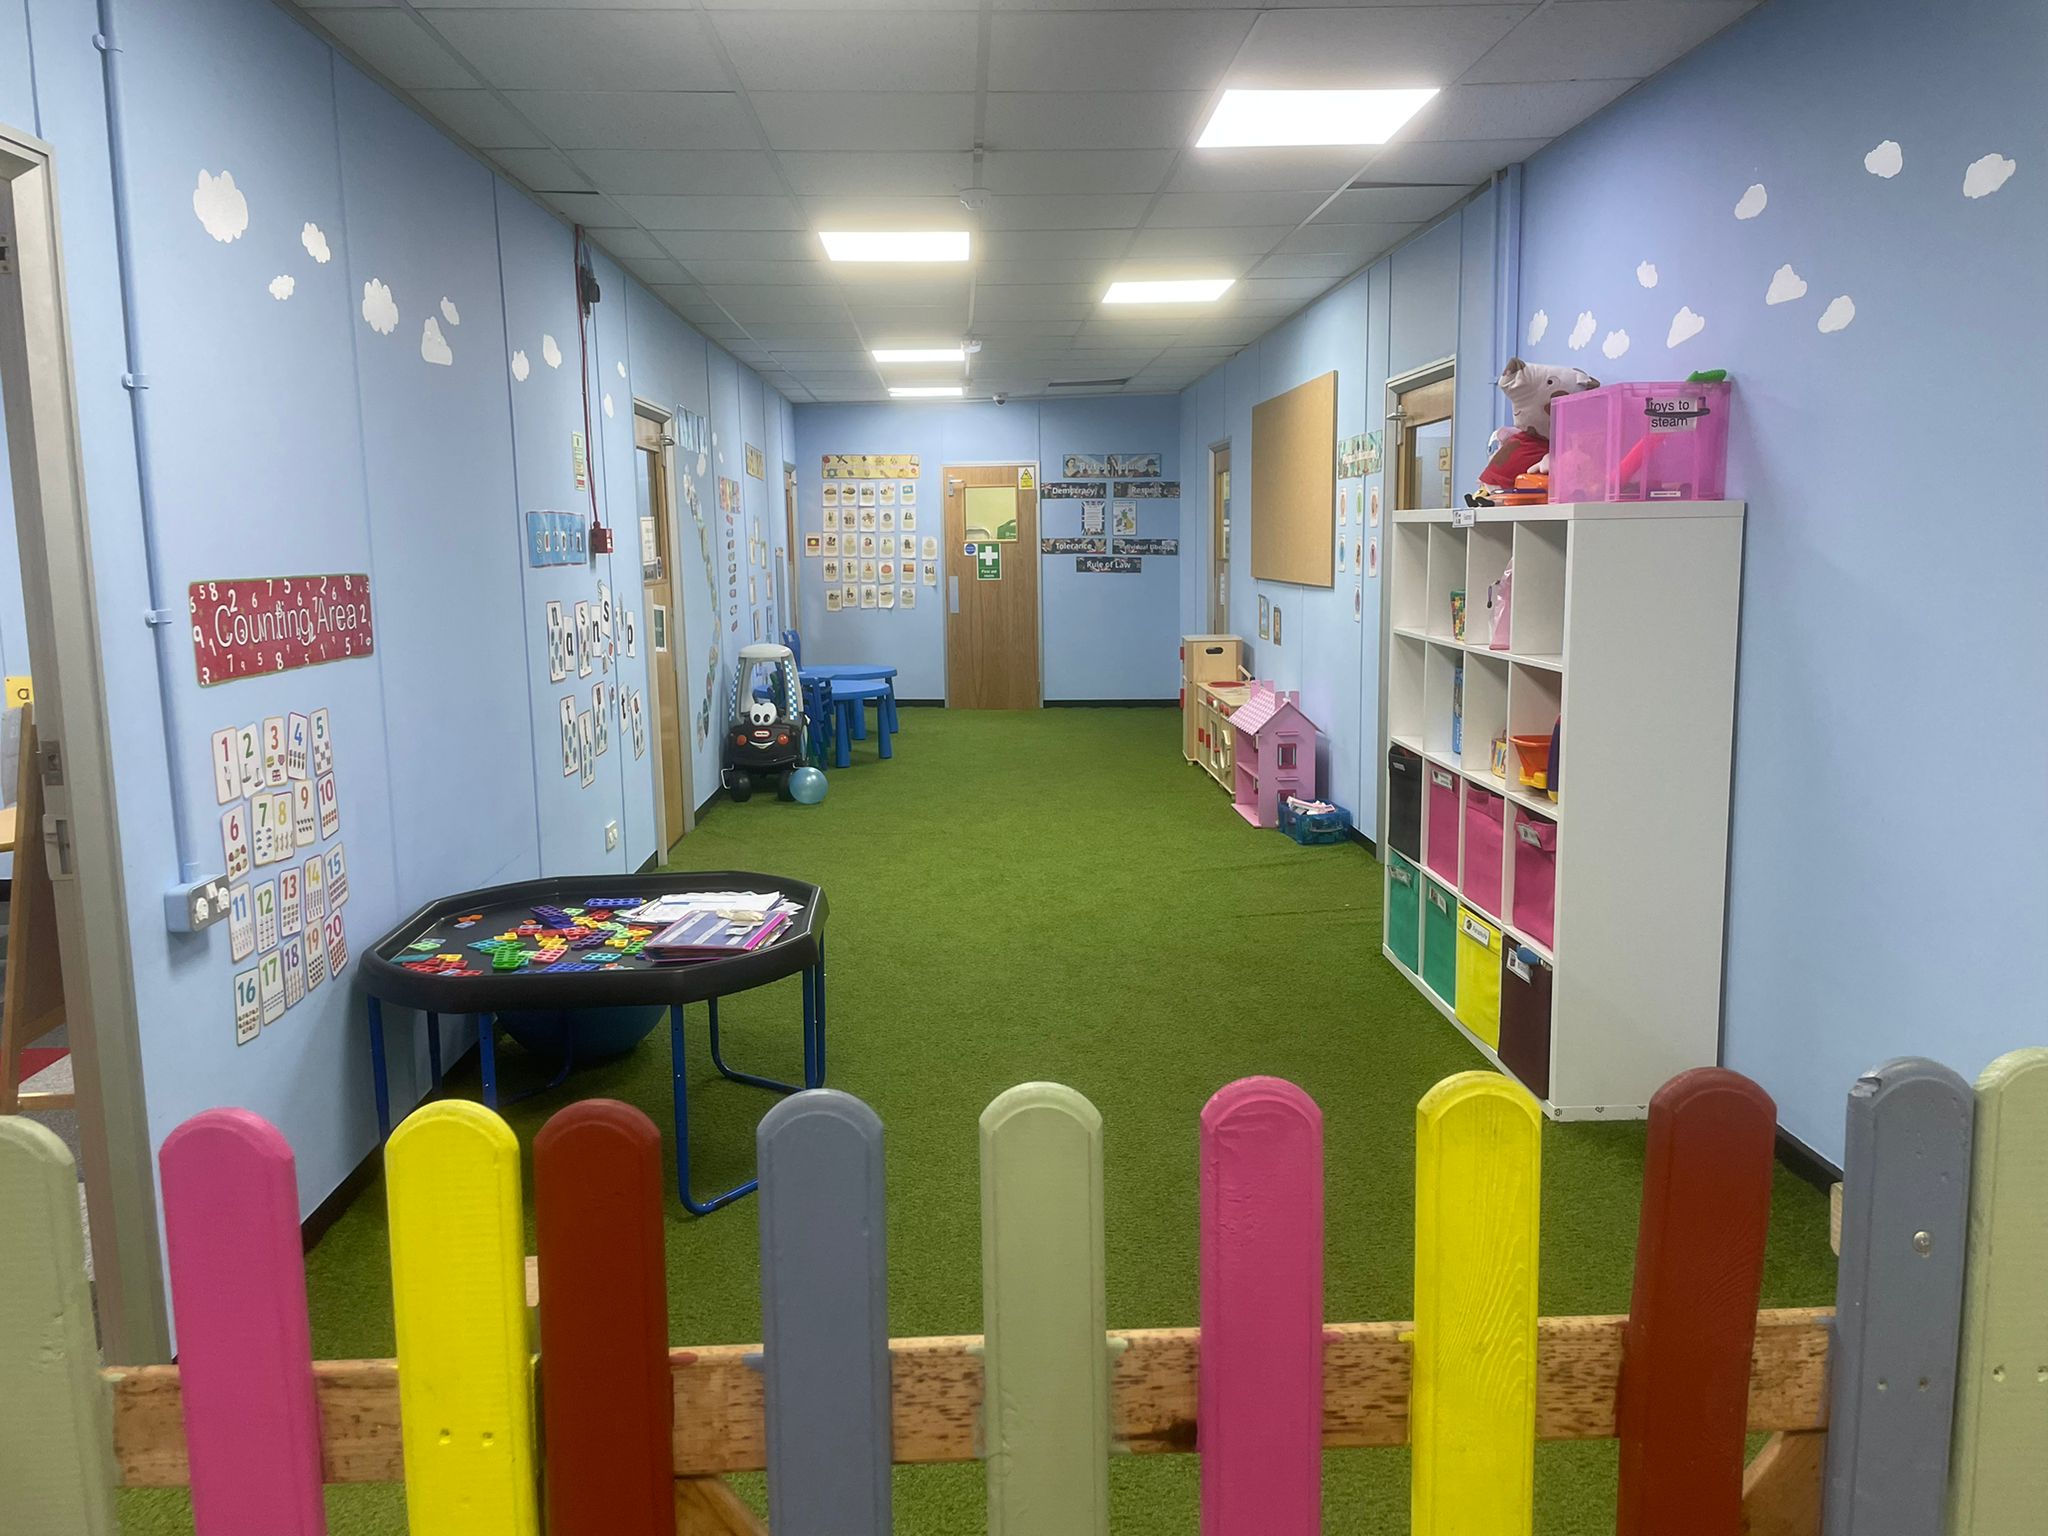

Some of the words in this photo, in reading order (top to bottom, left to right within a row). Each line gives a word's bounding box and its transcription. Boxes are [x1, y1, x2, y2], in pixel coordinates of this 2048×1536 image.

[1650, 401, 1675, 412] toys
[1678, 400, 1690, 410] to
[1651, 417, 1688, 428] steam
[1055, 542, 1093, 550] Tolerance
[1086, 560, 1104, 568] Rule
[199, 584, 206, 599] 5
[209, 582, 218, 601] 8
[266, 579, 272, 597] 7
[320, 576, 327, 595] 2
[332, 587, 337, 601] 6
[344, 575, 352, 591] 8
[228, 589, 238, 612] 2
[252, 592, 258, 608] 6
[297, 592, 303, 606] 6
[214, 601, 311, 647] Counting
[317, 598, 357, 634] Area
[360, 604, 367, 623] 2
[551, 606, 559, 627] n
[580, 606, 585, 626] s
[603, 600, 609, 623] s
[193, 625, 205, 648] 9
[592, 620, 600, 643] n
[627, 624, 633, 653] p
[209, 638, 217, 656] 1
[320, 643, 326, 660] 1
[345, 637, 351, 655] 5
[566, 632, 574, 656] a
[257, 652, 263, 666] 5
[275, 652, 284, 670] 8
[201, 667, 210, 686] 3
[17, 688, 30, 701] a
[270, 725, 279, 750] 3
[294, 723, 303, 746] 4
[316, 716, 324, 739] 5
[221, 736, 229, 762] 1
[243, 732, 254, 759] 2
[300, 786, 309, 810] 9
[319, 778, 334, 805] 10
[258, 802, 268, 827] 7
[278, 801, 287, 825] 8
[230, 815, 239, 841] 6
[306, 862, 320, 887] 14
[326, 851, 342, 880] 15
[282, 874, 298, 900] 13
[232, 892, 247, 922] 11
[257, 888, 274, 917] 12
[306, 927, 320, 955] 19
[325, 914, 343, 946] 20
[284, 943, 300, 971] 18
[261, 956, 278, 987] 17
[237, 977, 256, 1007] 16
